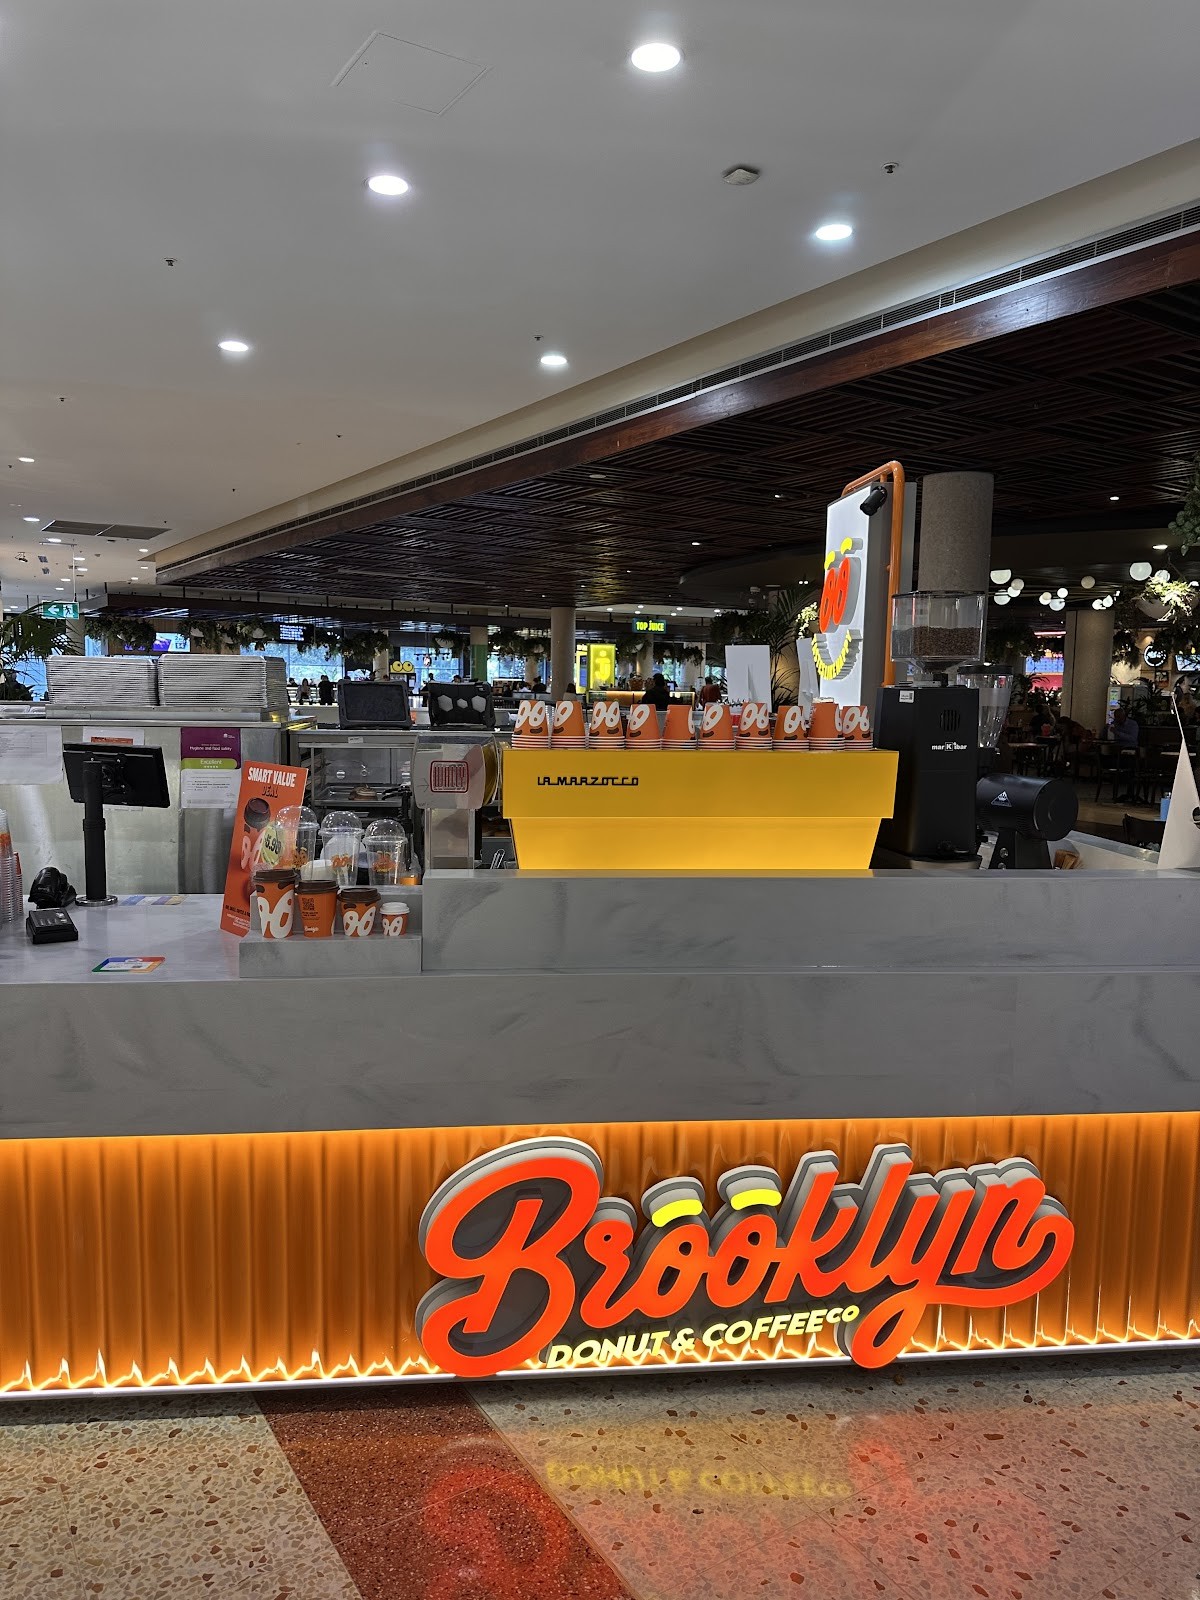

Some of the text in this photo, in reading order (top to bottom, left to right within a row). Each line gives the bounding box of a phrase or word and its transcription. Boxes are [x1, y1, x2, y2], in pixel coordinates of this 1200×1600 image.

[636, 620, 665, 631] TOP JUICE
[248, 766, 297, 788] SMART VALUE
[261, 786, 279, 799] DEAL
[420, 1154, 1075, 1377] Brooklyn
[545, 1330, 670, 1369] DONUT
[671, 1327, 696, 1352] &
[702, 1308, 827, 1348] COFFEE
